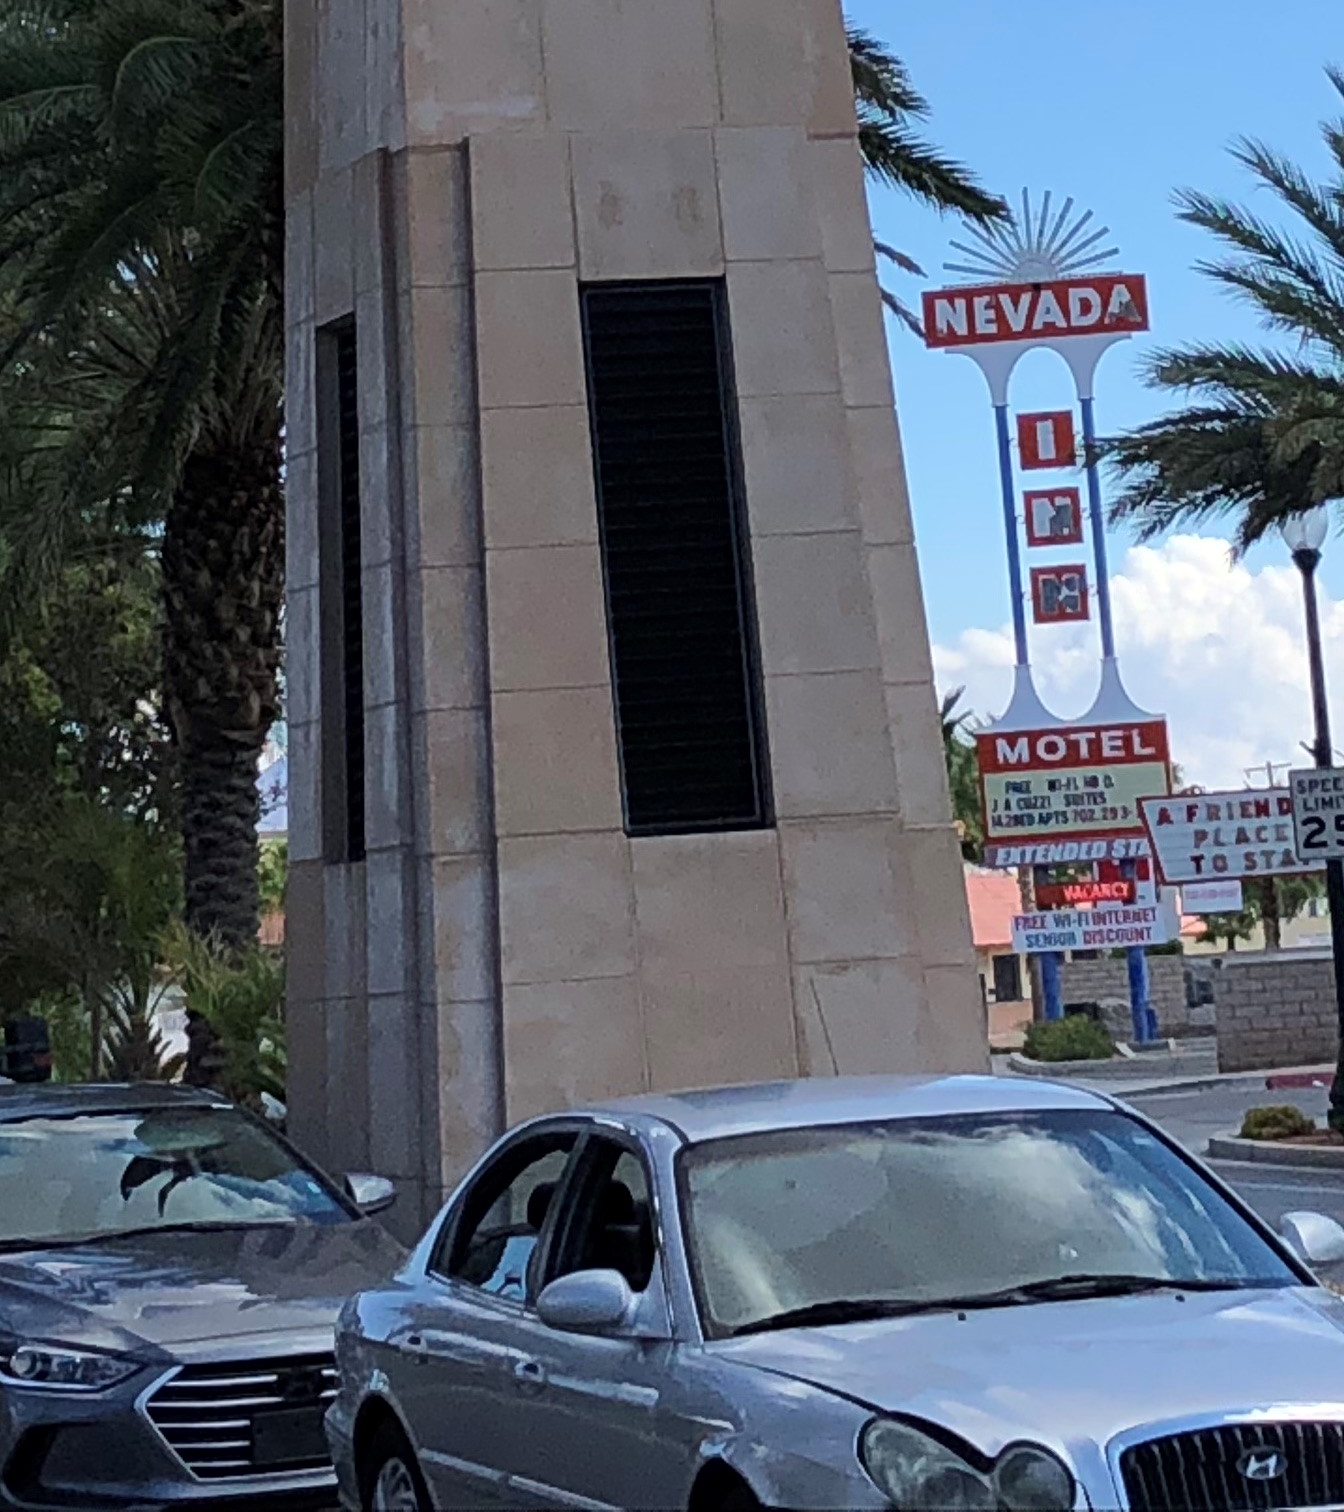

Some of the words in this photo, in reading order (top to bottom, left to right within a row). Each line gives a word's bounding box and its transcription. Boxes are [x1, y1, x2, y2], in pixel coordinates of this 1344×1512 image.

[934, 284, 1142, 336] NEVADA
[995, 729, 1156, 765] MOTEL
[1157, 806, 1174, 826] A
[1186, 795, 1293, 823] FRIEND
[1193, 822, 1289, 848] PLACE
[994, 841, 1106, 867] EXTENDED
[1189, 852, 1229, 875] TO
[1244, 847, 1310, 871] STA
[1063, 881, 1130, 902] VACANCY
[1013, 914, 1047, 931] FREE
[1091, 906, 1157, 926] INTERNET
[1025, 931, 1077, 948] SENIOR
[1082, 926, 1153, 945] DISCOUNT
